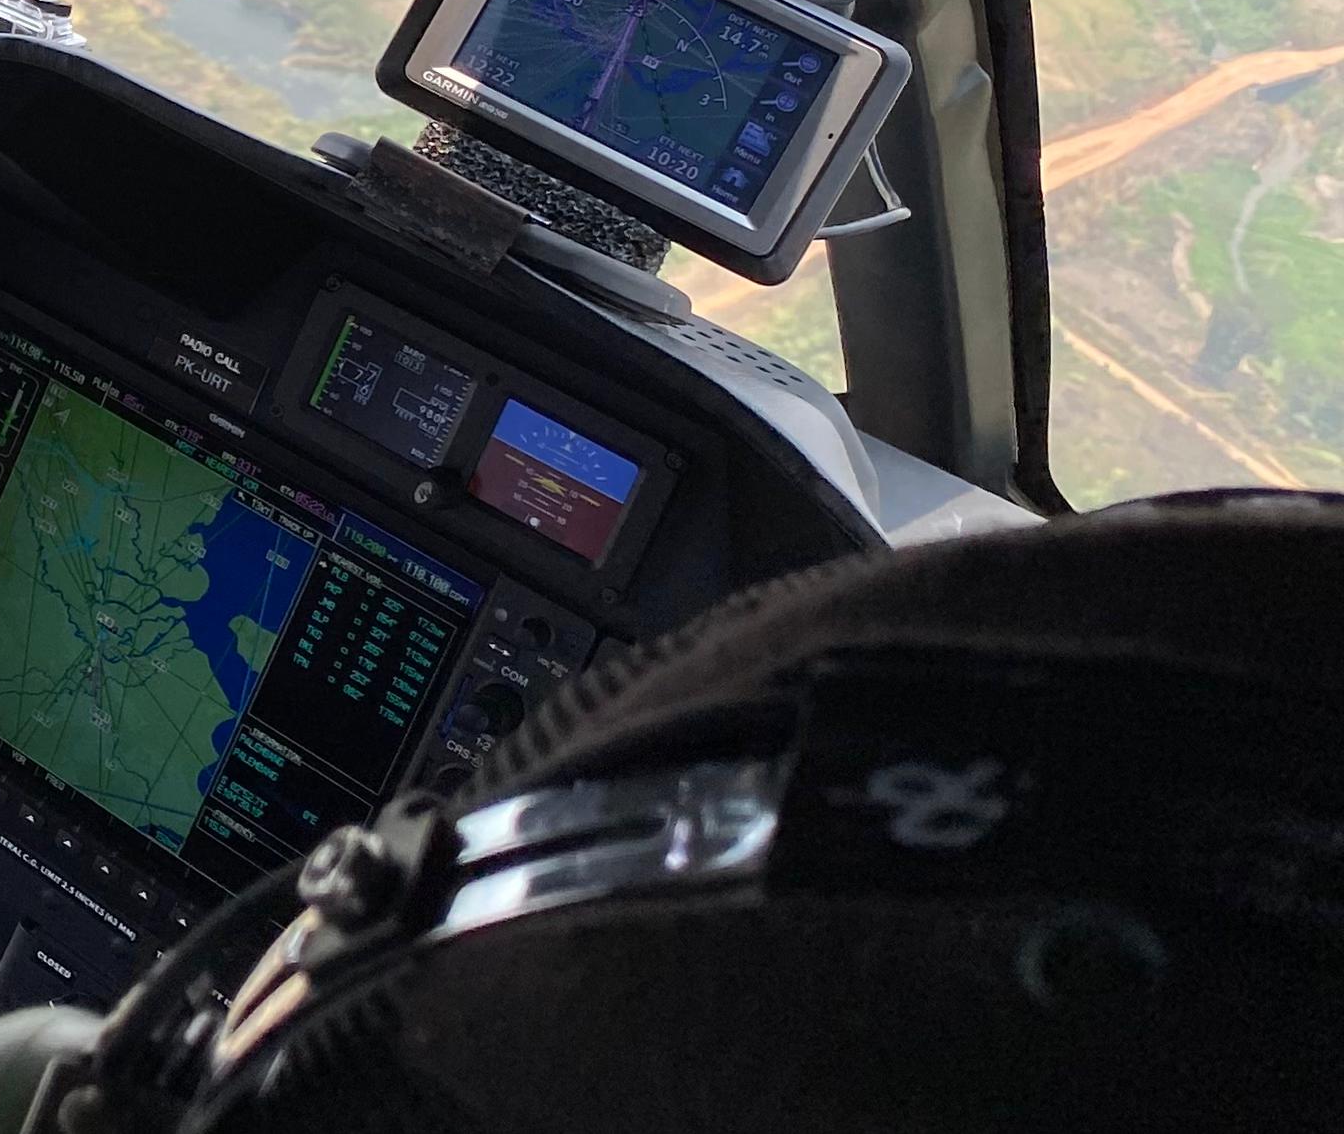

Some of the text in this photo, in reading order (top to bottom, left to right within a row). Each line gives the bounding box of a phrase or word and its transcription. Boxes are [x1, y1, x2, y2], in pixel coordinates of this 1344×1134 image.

[727, 13, 780, 42] DIST NEXT
[677, 40, 690, 52] N
[468, 54, 515, 87] 12:22
[783, 72, 802, 86] Out
[422, 70, 479, 105] GARMIN
[699, 94, 710, 106] 3
[647, 146, 699, 180] 10:20
[678, 145, 704, 162] NEXT
[733, 146, 761, 165] Menu
[179, 333, 241, 375] RADIO CALL
[174, 354, 232, 393] PK-URT
[241, 474, 260, 492] VOR
[500, 666, 529, 688] COM
[22, 853, 39, 870] C.G.
[40, 865, 61, 884] LIMIT
[61, 880, 75, 895] 2.5
[74, 888, 105, 917] INCHES
[36, 950, 72, 979] CLOSED
